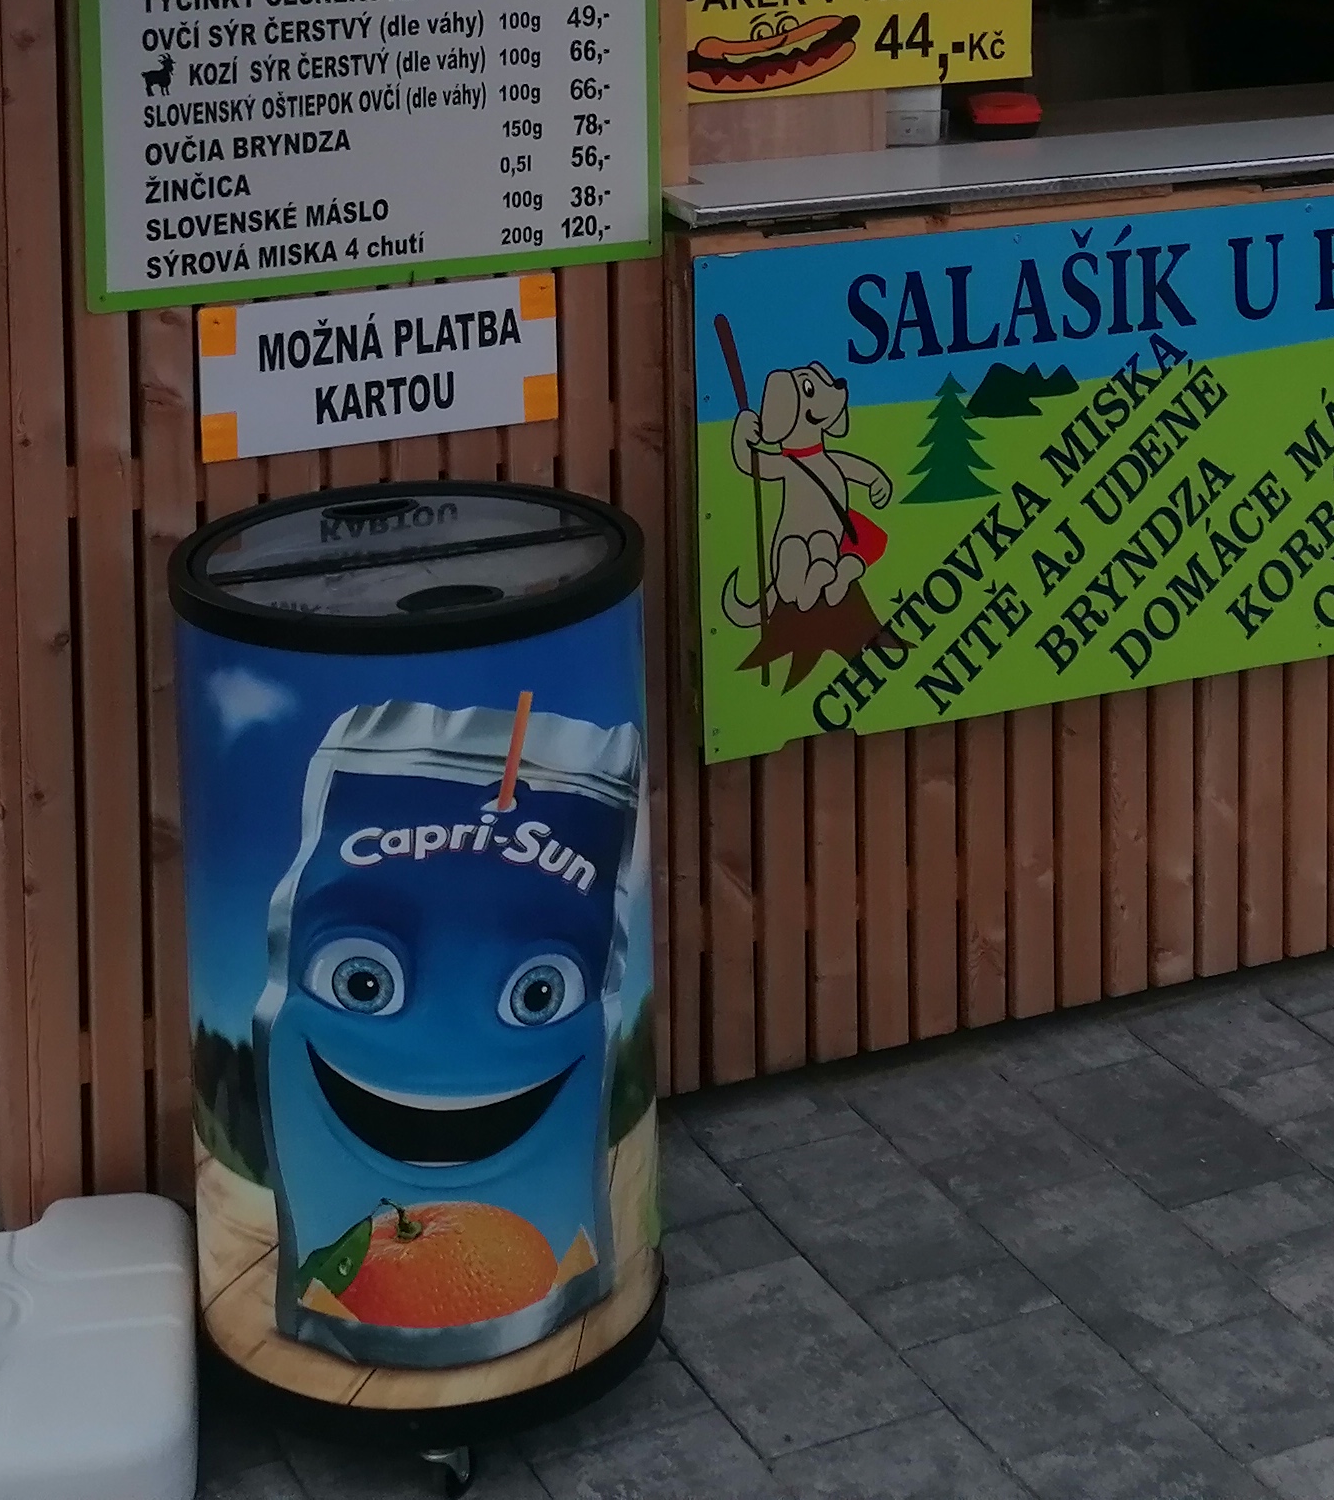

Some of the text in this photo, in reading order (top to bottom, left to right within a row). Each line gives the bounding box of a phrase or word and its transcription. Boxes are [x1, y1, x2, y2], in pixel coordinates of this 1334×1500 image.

[142, 6, 610, 52] OVČÍ SÝR ČERSTVÝ (dle váhy) 100g 49,-
[189, 40, 610, 86] KOZÍ SÝR ČERSTVÝ (dle váhy) 100g 66,-
[143, 78, 610, 128] SLOVENSKÝ OŠTIEPOK OVČÍ (dle váhy) 100g 66,-
[145, 113, 611, 167] OVČIA BRYNDZA 150g 78,-
[145, 173, 250, 204] ŽINČICA
[571, 146, 611, 171] 56,-
[146, 184, 611, 241] SLOVENSKÉ MÁSLO 100g 38,-
[146, 215, 611, 280] SÝROVÁ MISKA 4 chutí 200g 120,-
[846, 224, 1197, 366] SALAŠÍK
[1227, 234, 1283, 322] U
[258, 308, 521, 373] MOŽNÁ PLATBA
[316, 371, 455, 425] KARTOU
[812, 332, 1188, 733] CHUŤOVKA MISKA
[914, 359, 1228, 716] NITĚ AJ UDENÉ
[1034, 456, 1235, 676] BRYNDZA
[1109, 469, 1293, 680] DOMÁCE
[340, 814, 597, 895] Capri-Sun
